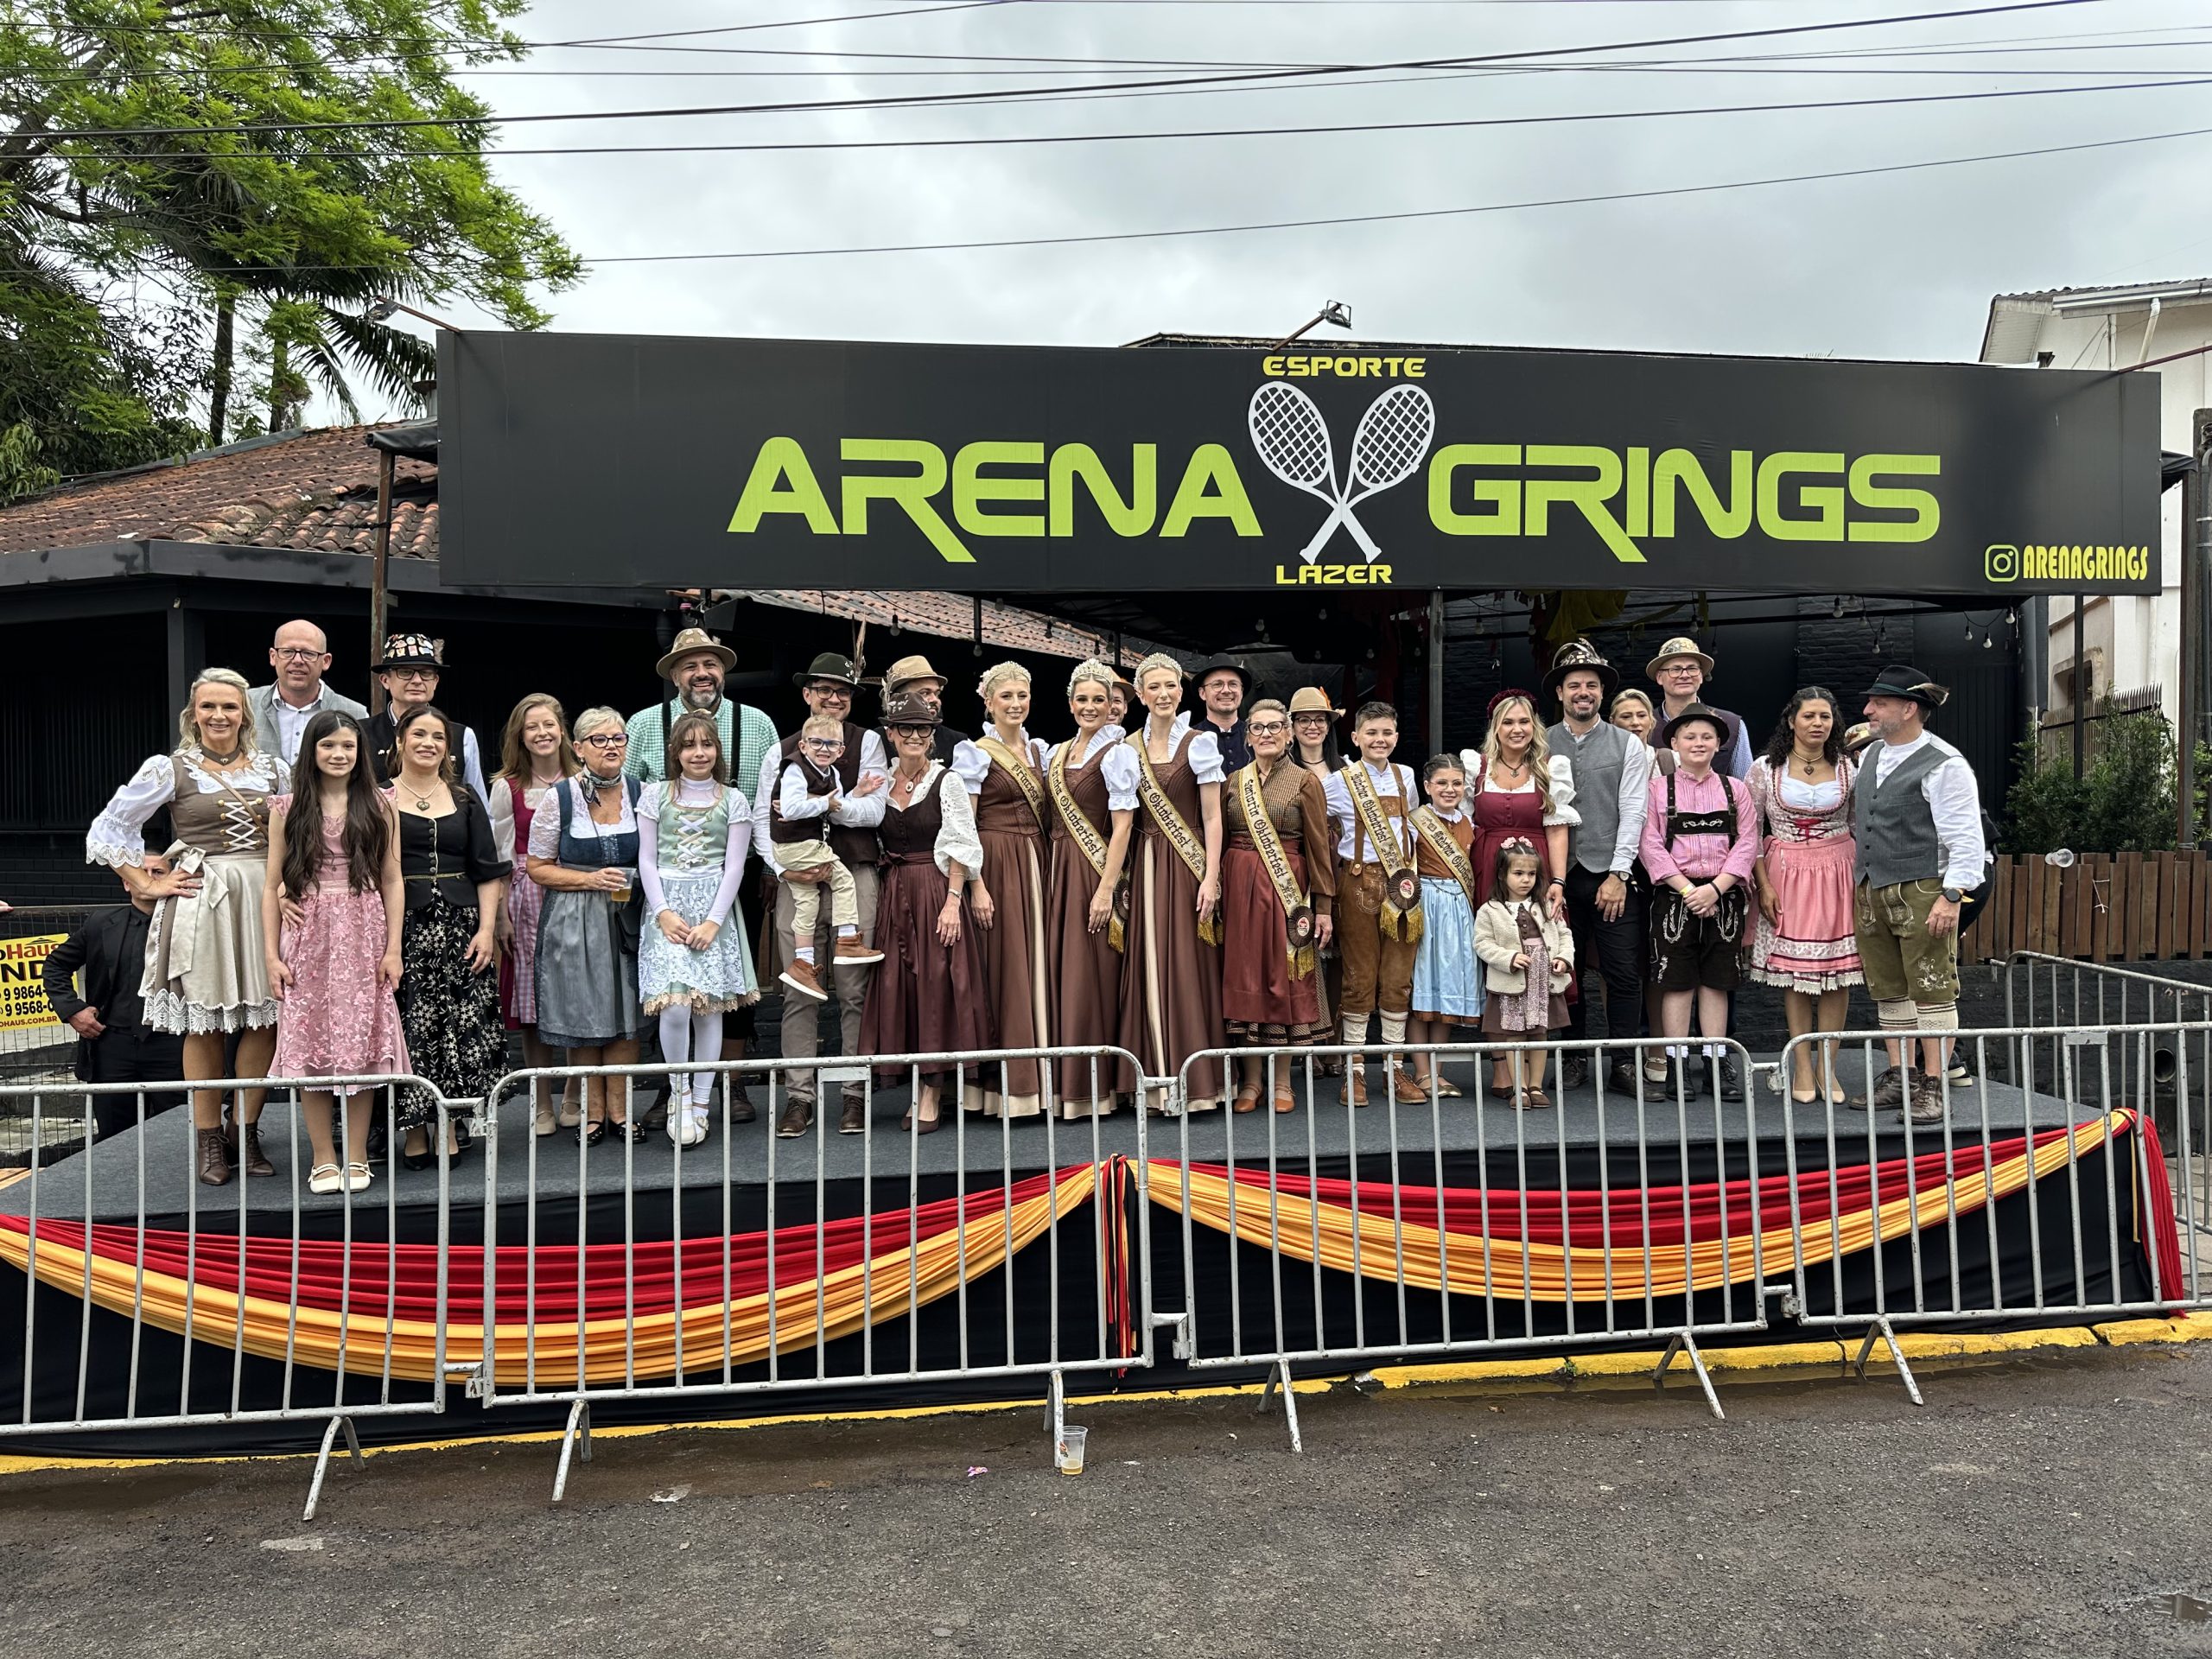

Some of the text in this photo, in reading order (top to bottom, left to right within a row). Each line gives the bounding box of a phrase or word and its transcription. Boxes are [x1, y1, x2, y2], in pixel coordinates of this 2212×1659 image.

[1262, 356, 1426, 378] ESPORTE
[727, 436, 1941, 563] ARENA GRINGS
[1275, 564, 1393, 584] LAZER
[2023, 544, 2148, 581] ARENAGRINGS
[1011, 763, 1039, 802] Princesa
[1060, 795, 1102, 855] Oktoberfest
[1149, 792, 1191, 848] Oktoberfest
[1243, 779, 1287, 879] Seniorin Oktoberfest
[1362, 799, 1390, 844] Oktoberfest
[3, 988, 10, 1001] 9
[5, 1003, 12, 1017] 9
